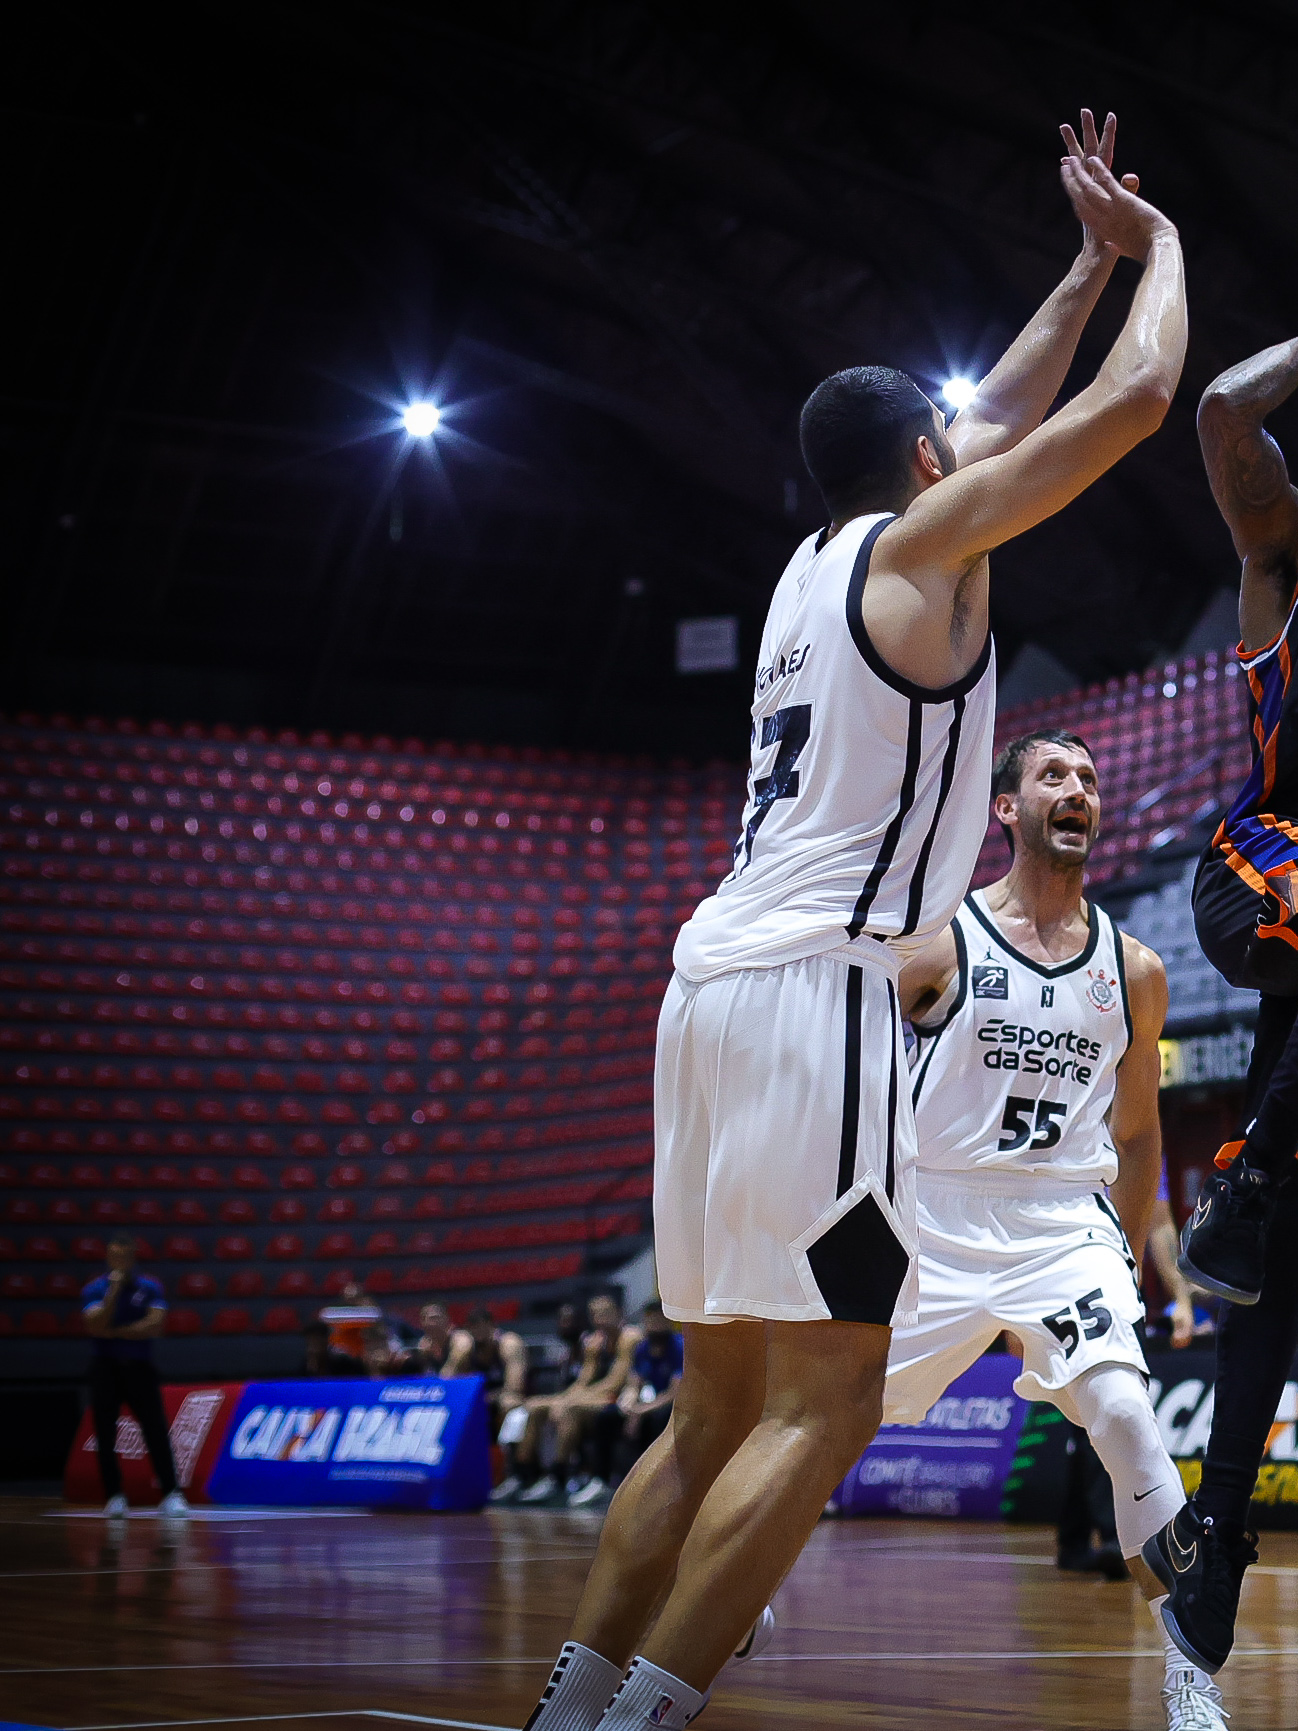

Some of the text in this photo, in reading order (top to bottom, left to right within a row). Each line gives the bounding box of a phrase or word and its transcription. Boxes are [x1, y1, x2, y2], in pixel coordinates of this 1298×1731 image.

[977, 1018, 1102, 1061] Esportes
[997, 1095, 1068, 1152] 55
[1041, 1287, 1113, 1361] 55
[230, 1404, 343, 1463] CAIXA
